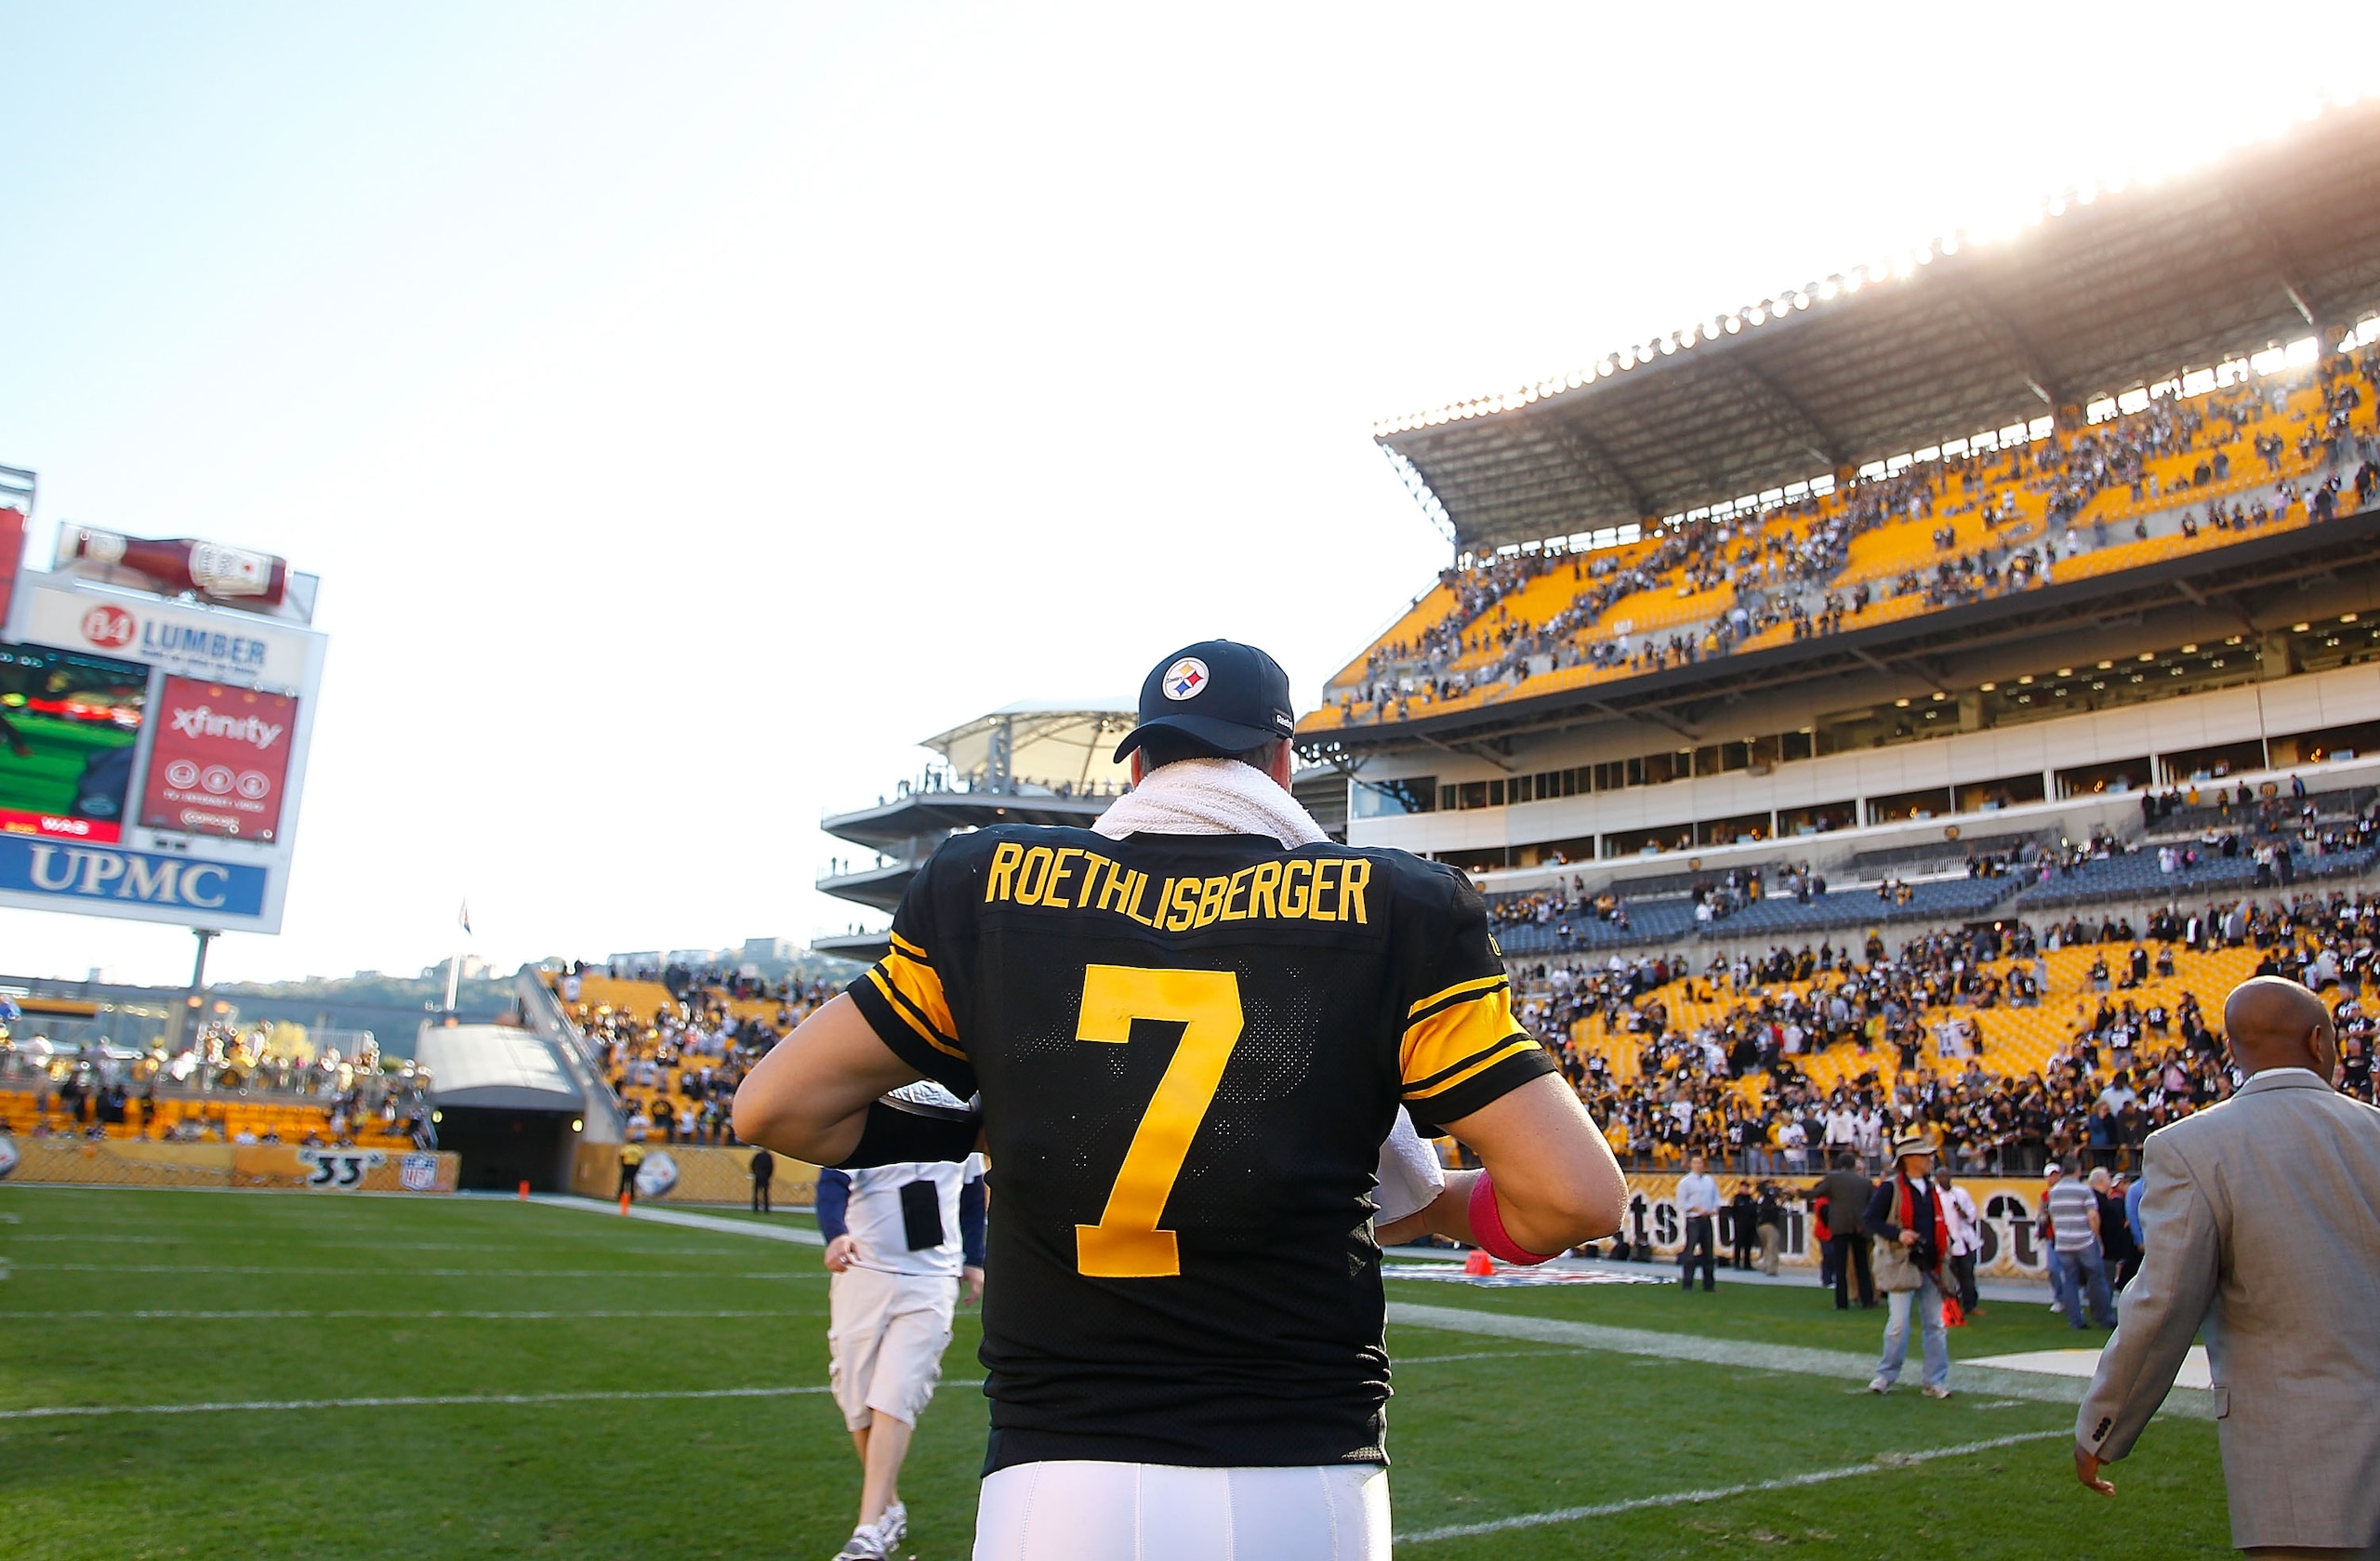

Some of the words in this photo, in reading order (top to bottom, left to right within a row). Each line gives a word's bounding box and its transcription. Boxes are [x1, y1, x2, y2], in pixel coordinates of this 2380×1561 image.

[86, 609, 131, 643] 84
[144, 621, 266, 666] LUMBER
[171, 706, 284, 749] xfinity
[41, 816, 90, 836] WAS
[29, 843, 230, 908] UPMC
[985, 841, 1372, 932] ROETHLISBERGER
[1076, 964, 1245, 1277] 7
